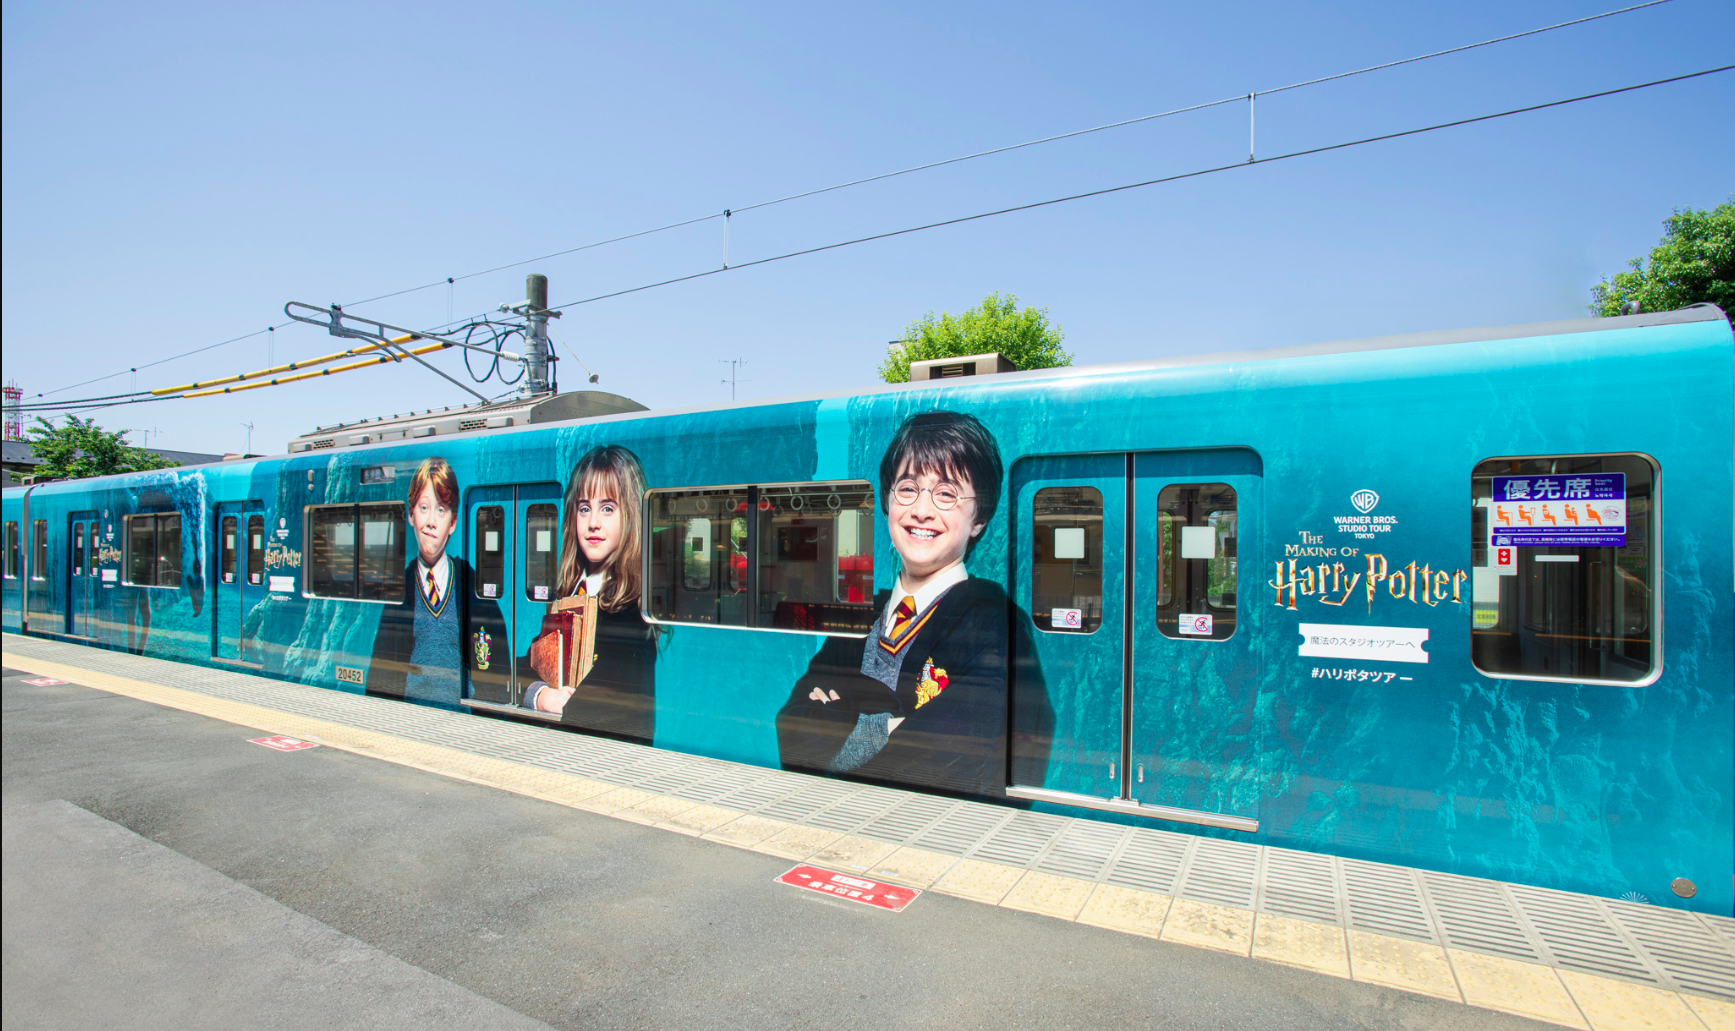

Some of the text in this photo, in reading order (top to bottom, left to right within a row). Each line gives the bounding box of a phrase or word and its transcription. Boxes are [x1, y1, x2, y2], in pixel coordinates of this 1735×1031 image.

[1503, 477, 1592, 500] 優先席
[1353, 492, 1376, 510] WB
[1333, 515, 1398, 524] WARNER BROS.
[1338, 524, 1392, 532] STUDIO TOUR
[264, 545, 302, 571] Harry Potter
[1268, 553, 1468, 617] Harry Potter
[1310, 635, 1415, 649] 魔法のスタジオツアーへ
[336, 666, 361, 682] 20452
[1311, 667, 1413, 683] #ハリポタツアー
